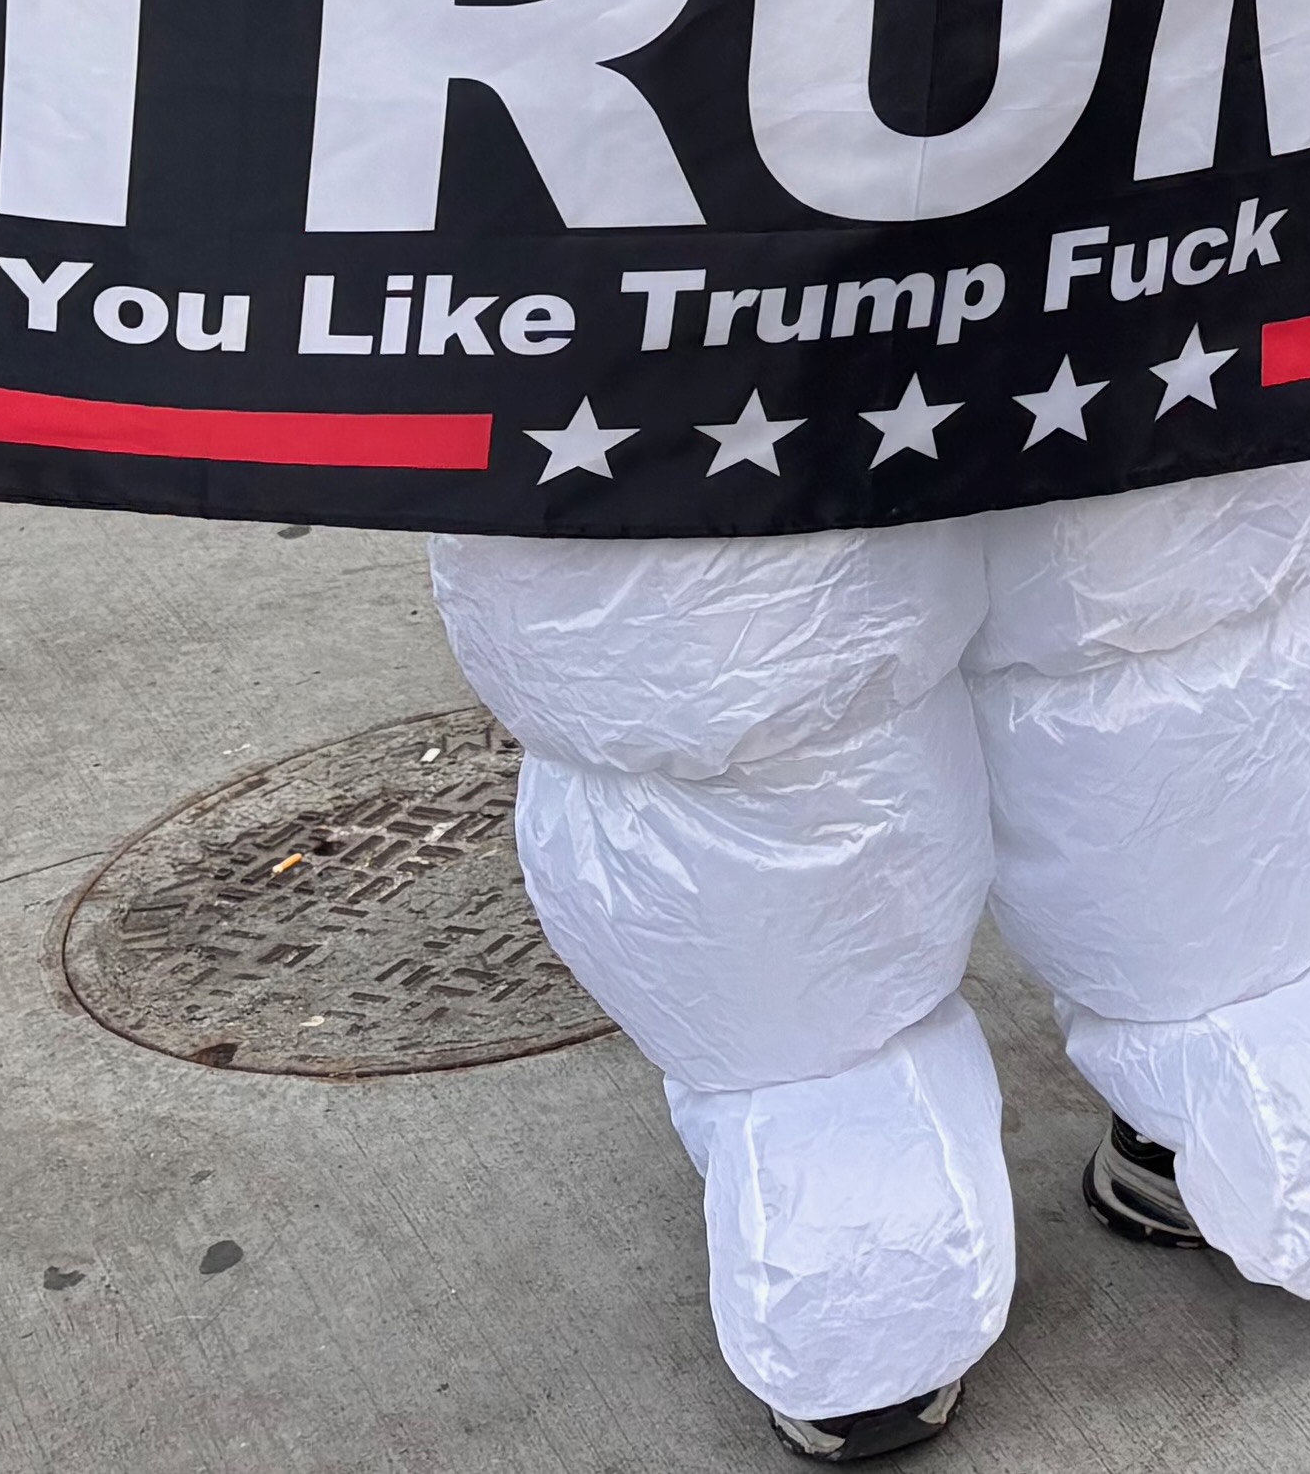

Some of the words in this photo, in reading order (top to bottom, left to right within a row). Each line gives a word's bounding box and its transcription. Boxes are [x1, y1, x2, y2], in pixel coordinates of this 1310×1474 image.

[297, 274, 576, 356] Like
[620, 263, 1006, 351] Trump
[1043, 197, 1288, 313] Fuck
